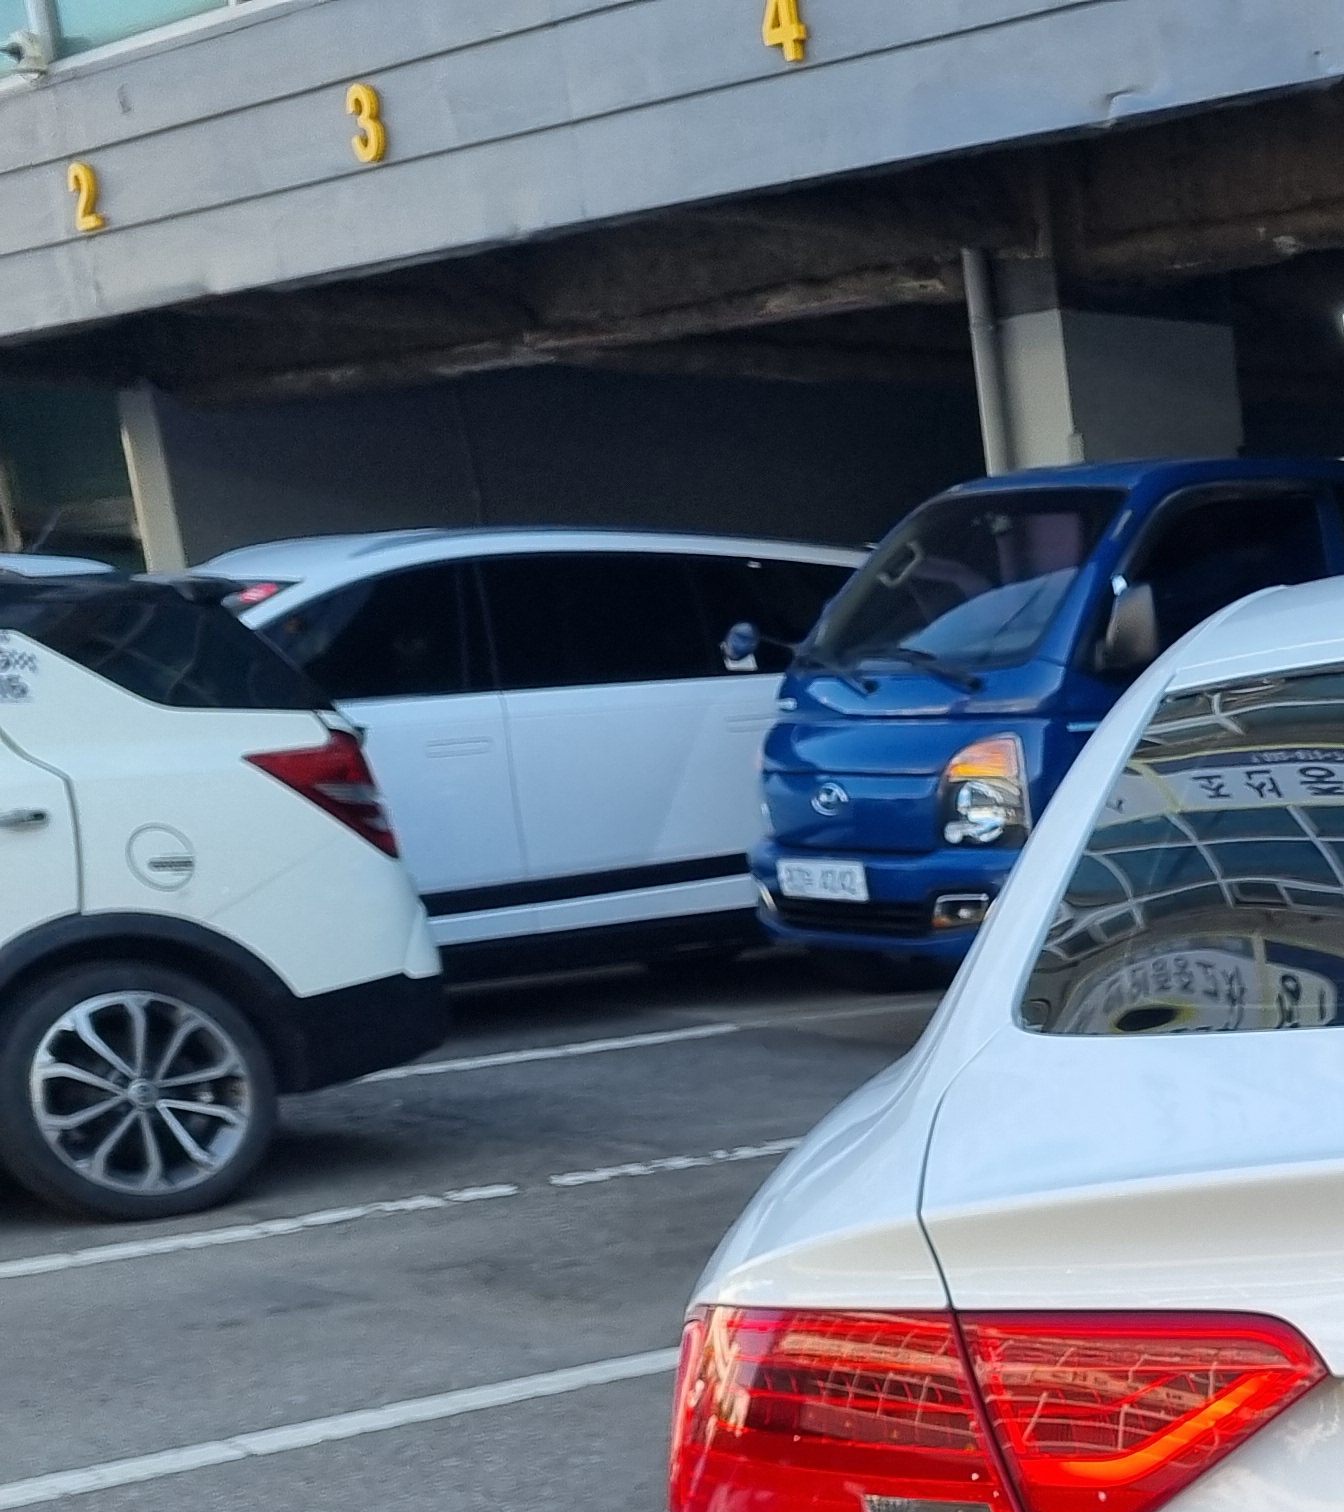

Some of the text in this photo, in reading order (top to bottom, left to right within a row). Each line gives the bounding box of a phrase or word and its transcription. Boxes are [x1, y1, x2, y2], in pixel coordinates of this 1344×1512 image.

[762, 0, 807, 61] 4
[346, 83, 387, 163] 3
[68, 162, 106, 232] 2
